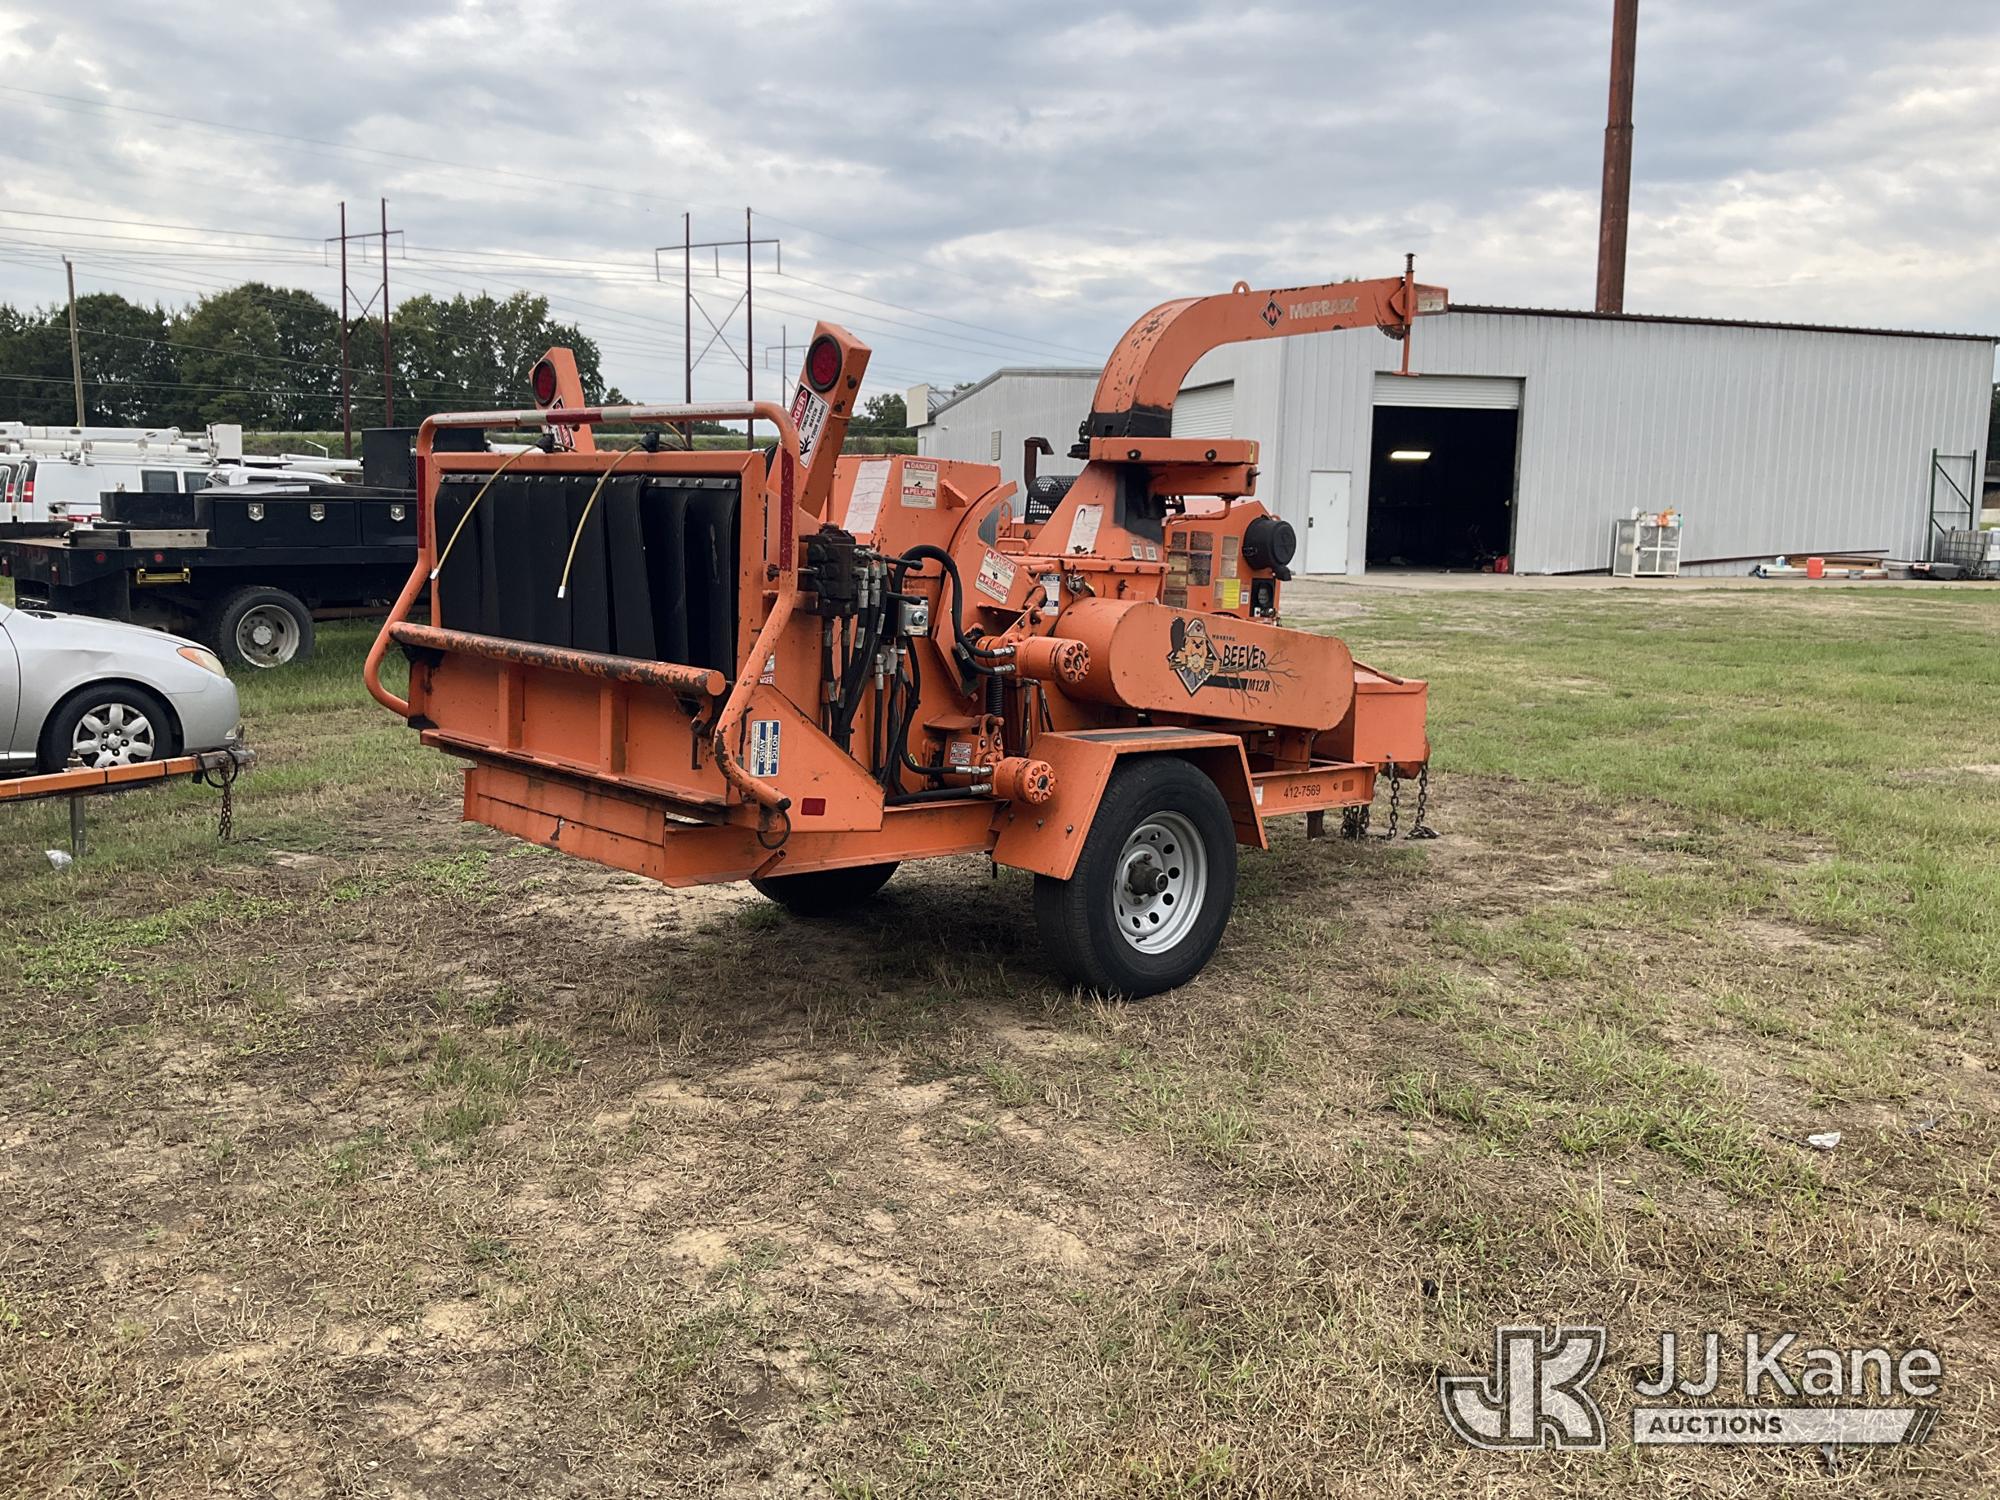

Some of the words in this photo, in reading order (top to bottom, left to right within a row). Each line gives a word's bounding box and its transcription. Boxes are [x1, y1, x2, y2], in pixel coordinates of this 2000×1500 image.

[1289, 297, 1360, 320] MORBARK
[910, 462, 935, 471] DANGER
[984, 577, 1008, 596] PELIGRO
[1223, 644, 1266, 669] BEEVER
[1248, 679, 1270, 692] M12R
[1284, 784, 1321, 799] 412-7569
